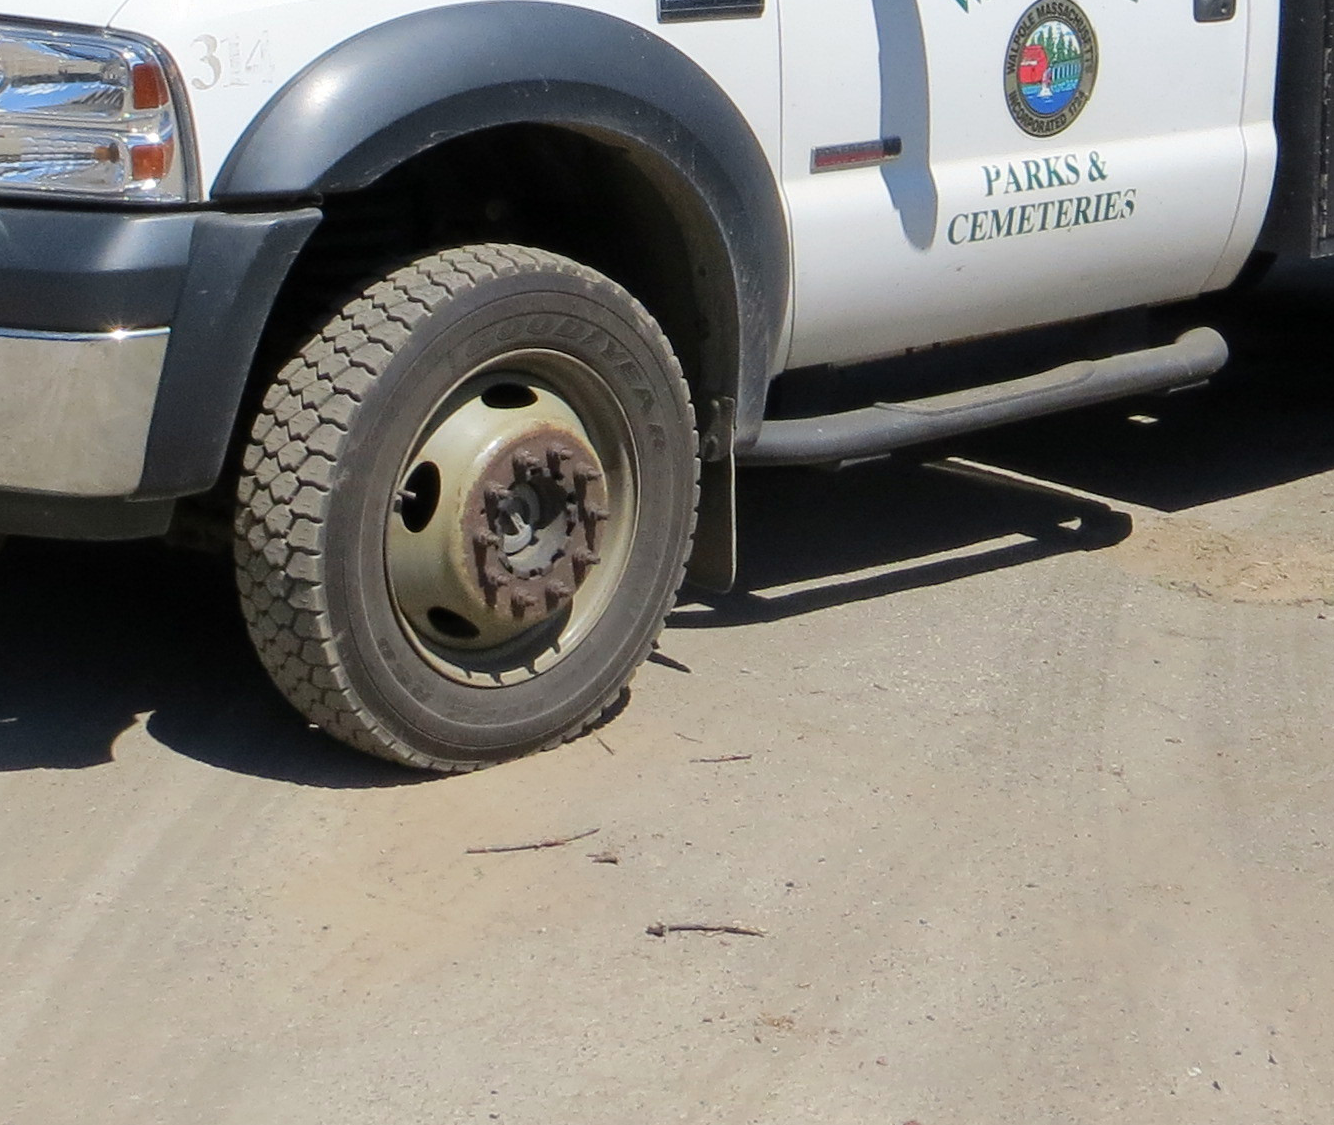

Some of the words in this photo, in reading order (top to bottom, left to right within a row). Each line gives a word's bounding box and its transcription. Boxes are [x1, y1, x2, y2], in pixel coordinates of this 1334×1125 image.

[1007, 13, 1036, 75] WALPOLE
[1036, 2, 1094, 74] MASSACHUSETTS
[1008, 91, 1067, 132] INCORPORATED
[981, 153, 1080, 197] PARKS
[1087, 151, 1109, 182] &
[947, 188, 1137, 245] CEMETERIES
